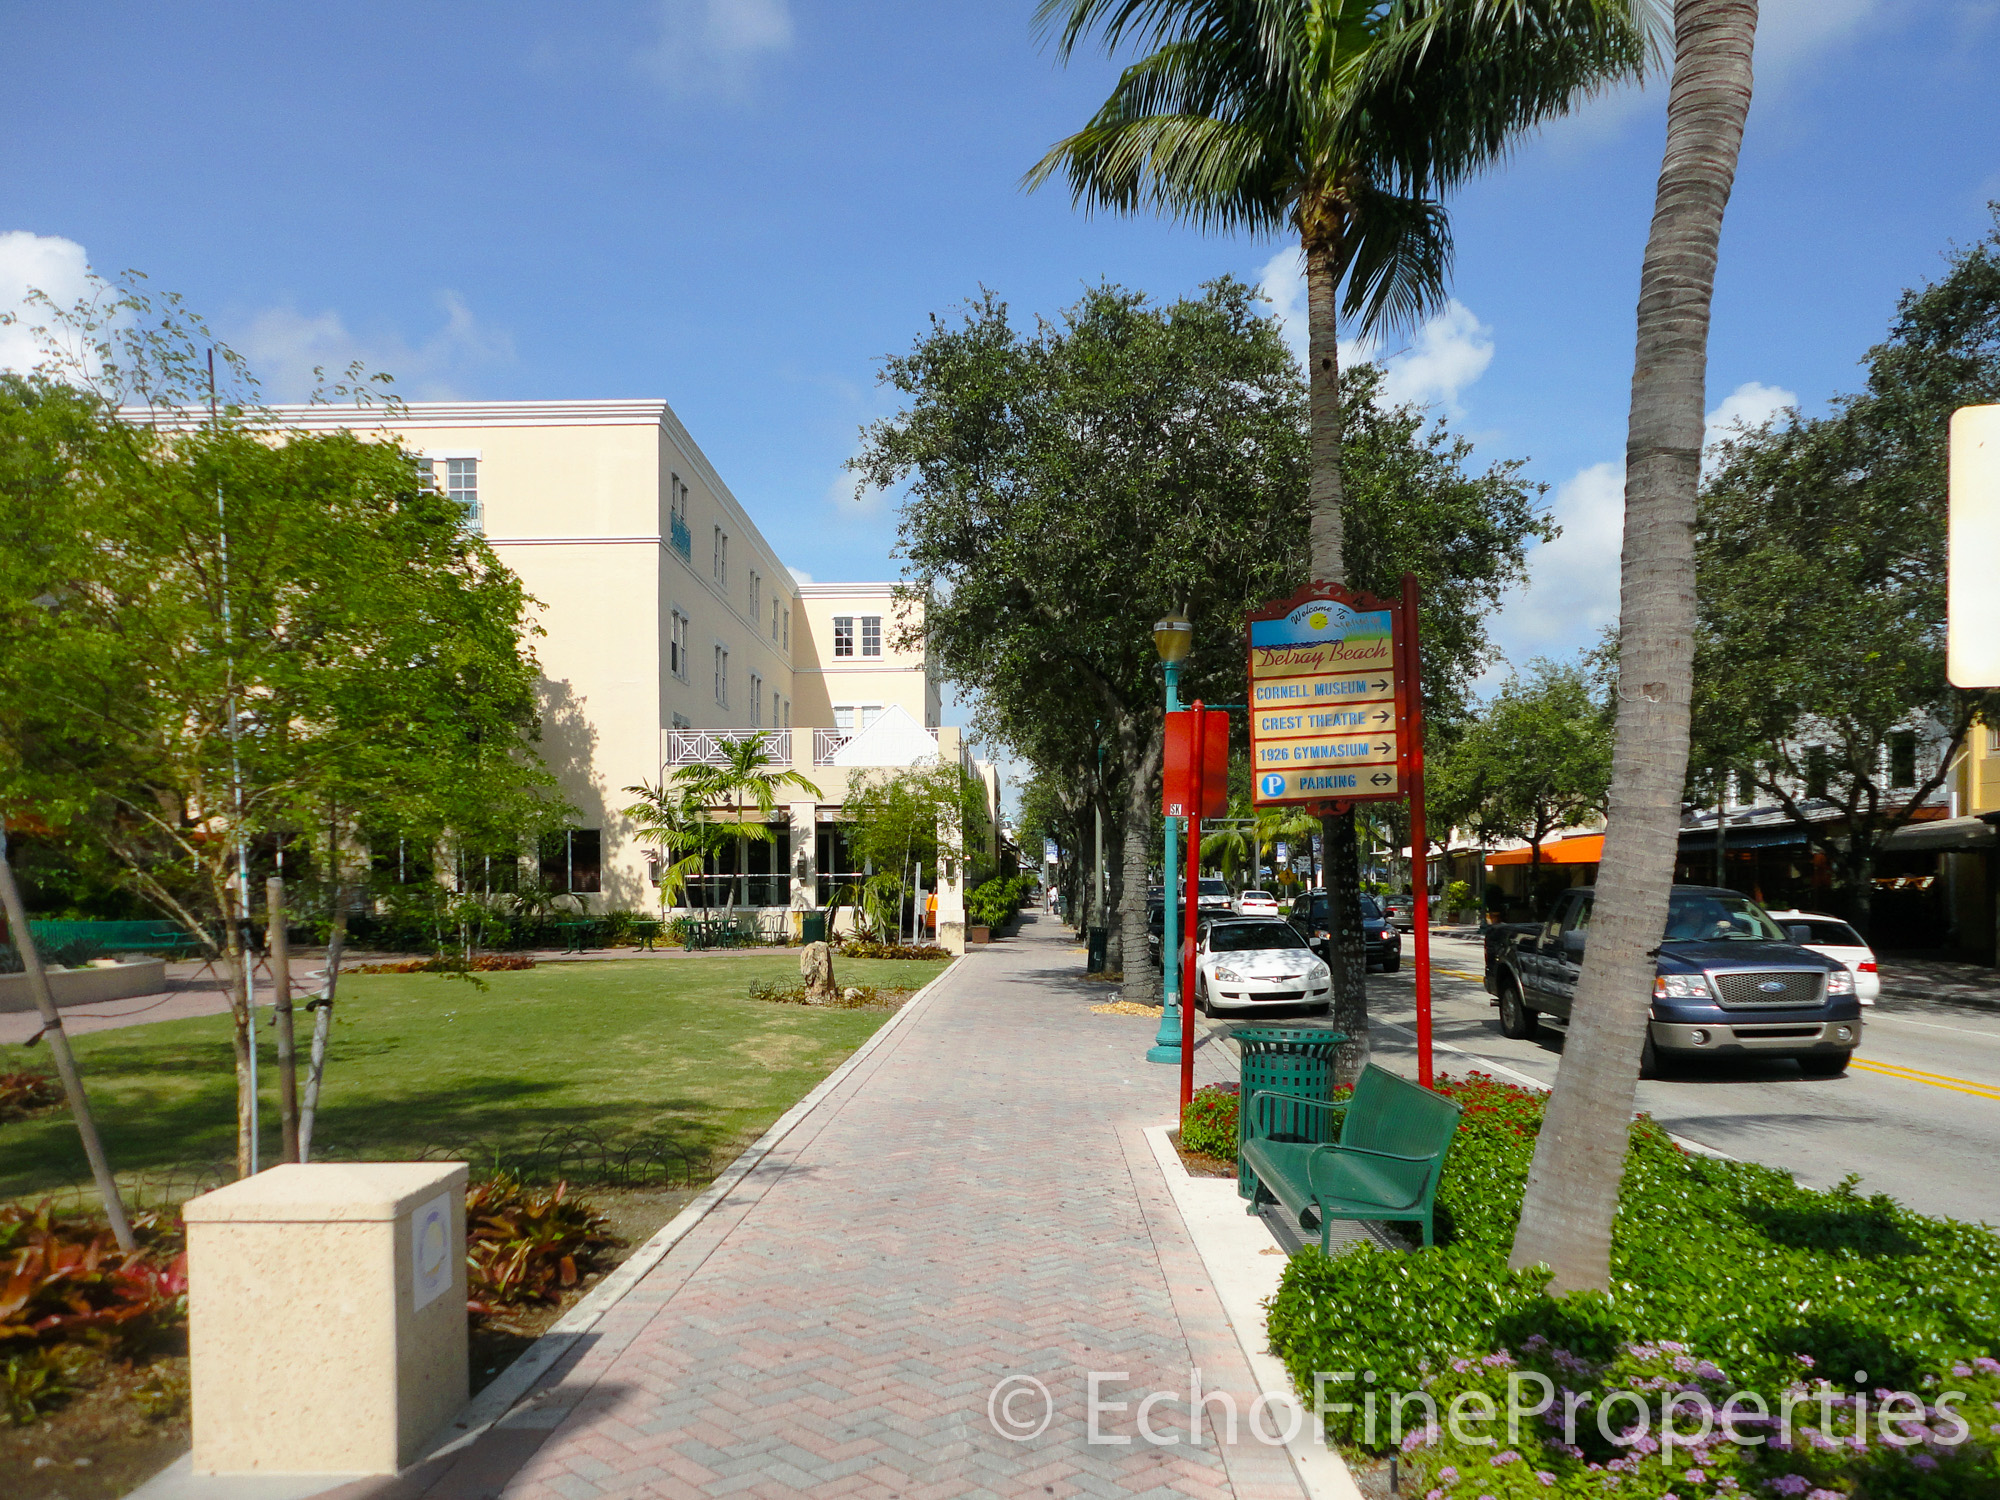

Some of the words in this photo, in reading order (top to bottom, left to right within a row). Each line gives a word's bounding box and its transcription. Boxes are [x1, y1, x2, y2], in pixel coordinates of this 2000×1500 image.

[1290, 604, 1332, 625] Welcome
[1336, 607, 1350, 620] To
[1255, 647, 1324, 670] Delray
[1328, 637, 1388, 662] Beach
[1256, 684, 1310, 700] CORNELL
[1314, 680, 1367, 696] MUSEUM
[1262, 715, 1302, 731] CREST
[1309, 711, 1366, 728] THEATRE
[1260, 747, 1289, 762] 1926
[1294, 742, 1369, 759] GYMNASIUM
[1267, 776, 1282, 795] P
[1300, 774, 1357, 790] PARKING
